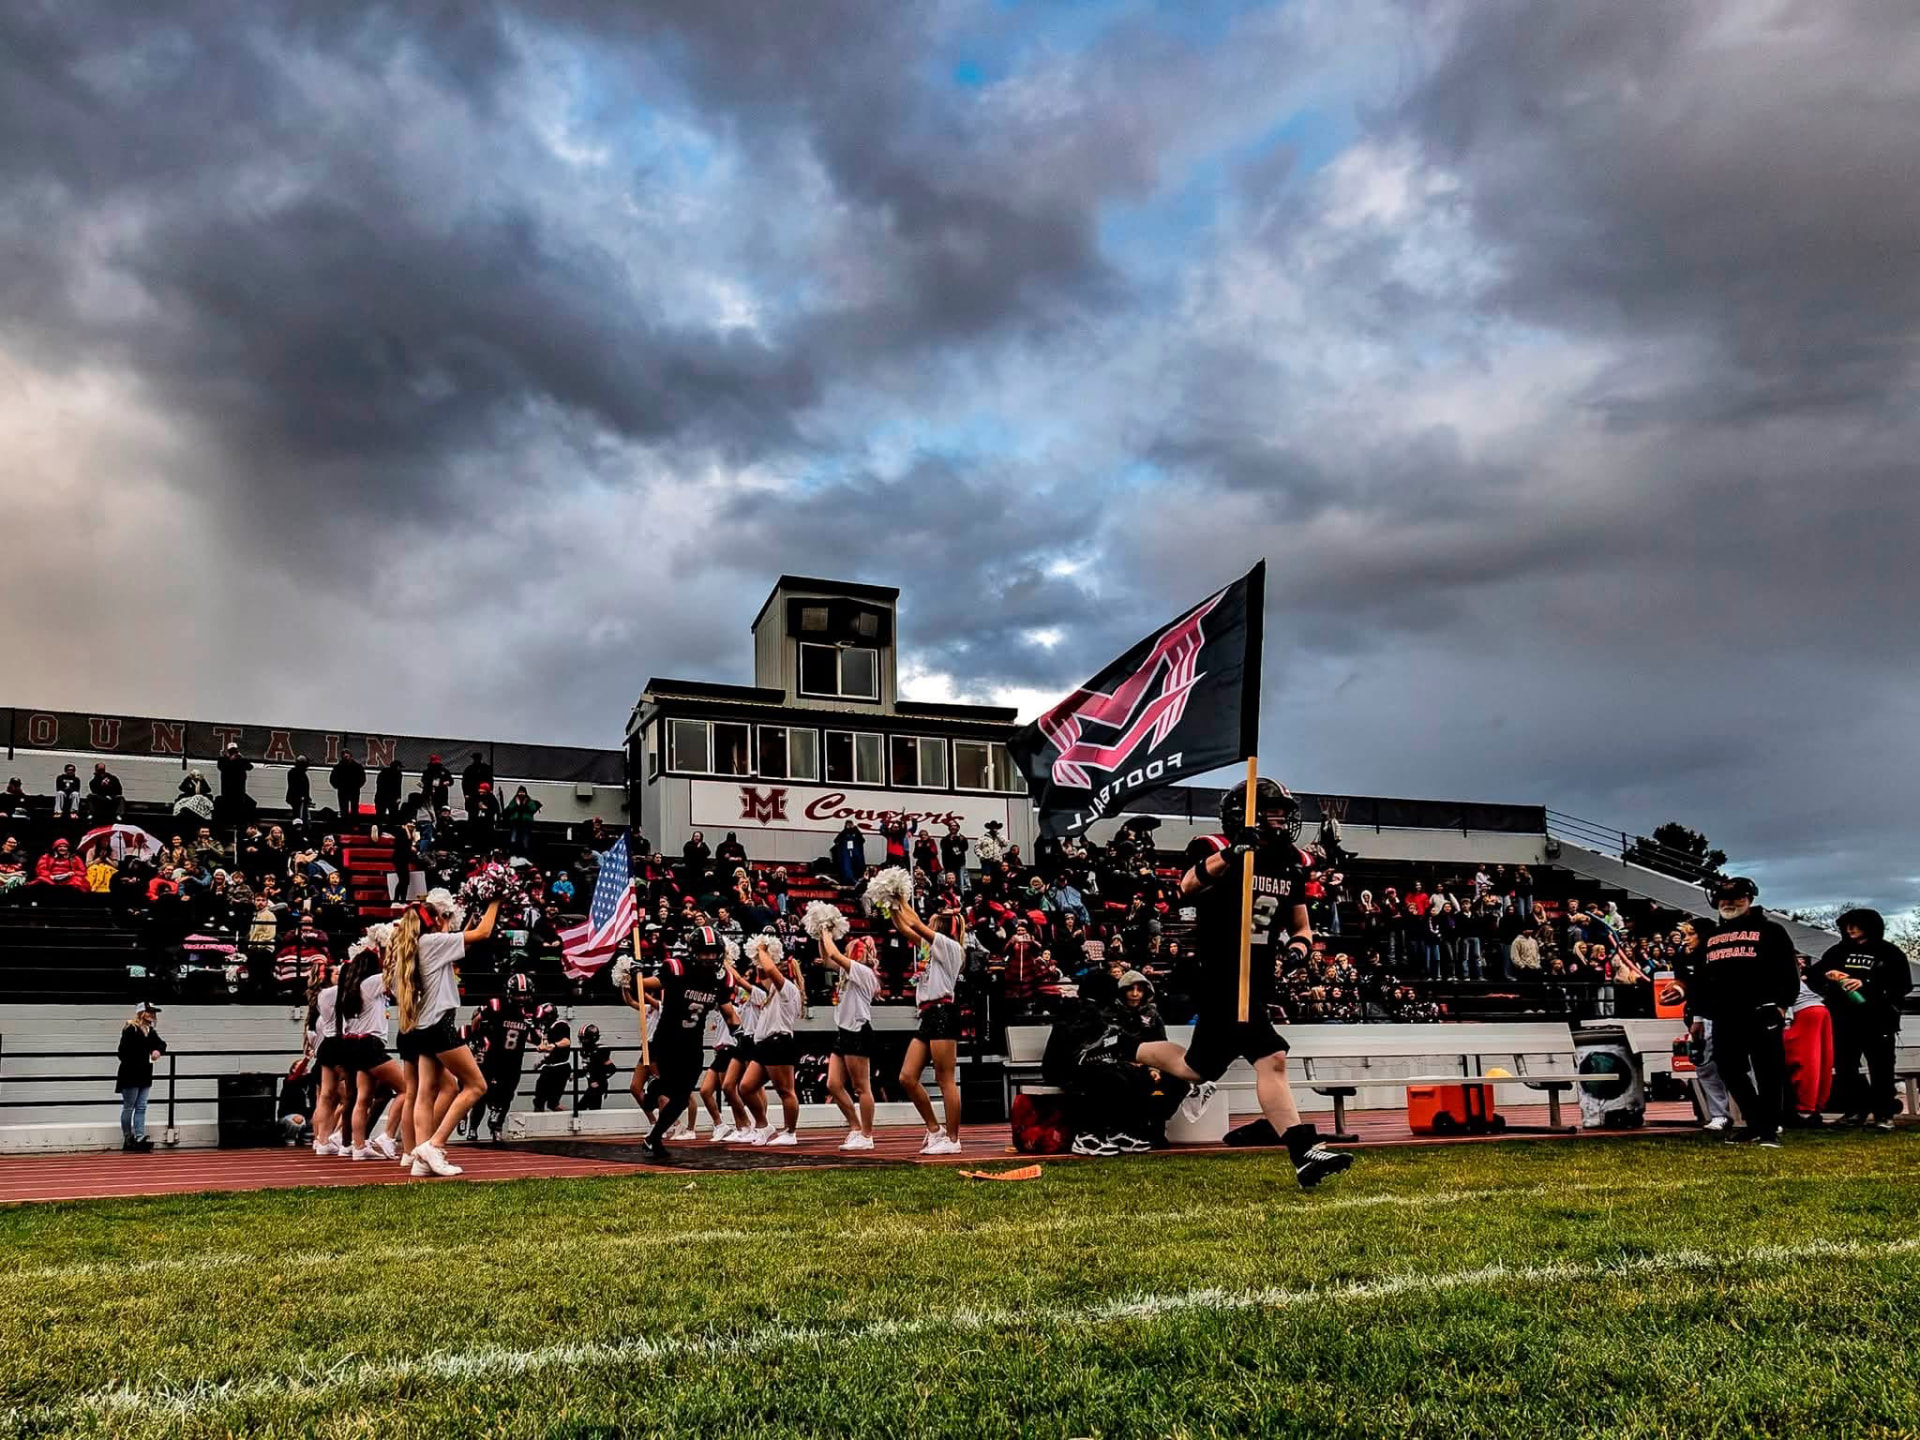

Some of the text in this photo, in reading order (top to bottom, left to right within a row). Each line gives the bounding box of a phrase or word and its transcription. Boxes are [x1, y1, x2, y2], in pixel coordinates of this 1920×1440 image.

[1252, 875, 1292, 896] OUGARS
[684, 989, 716, 1003] COUGARS
[682, 1003, 704, 1029] 3
[504, 1029, 520, 1050] 8
